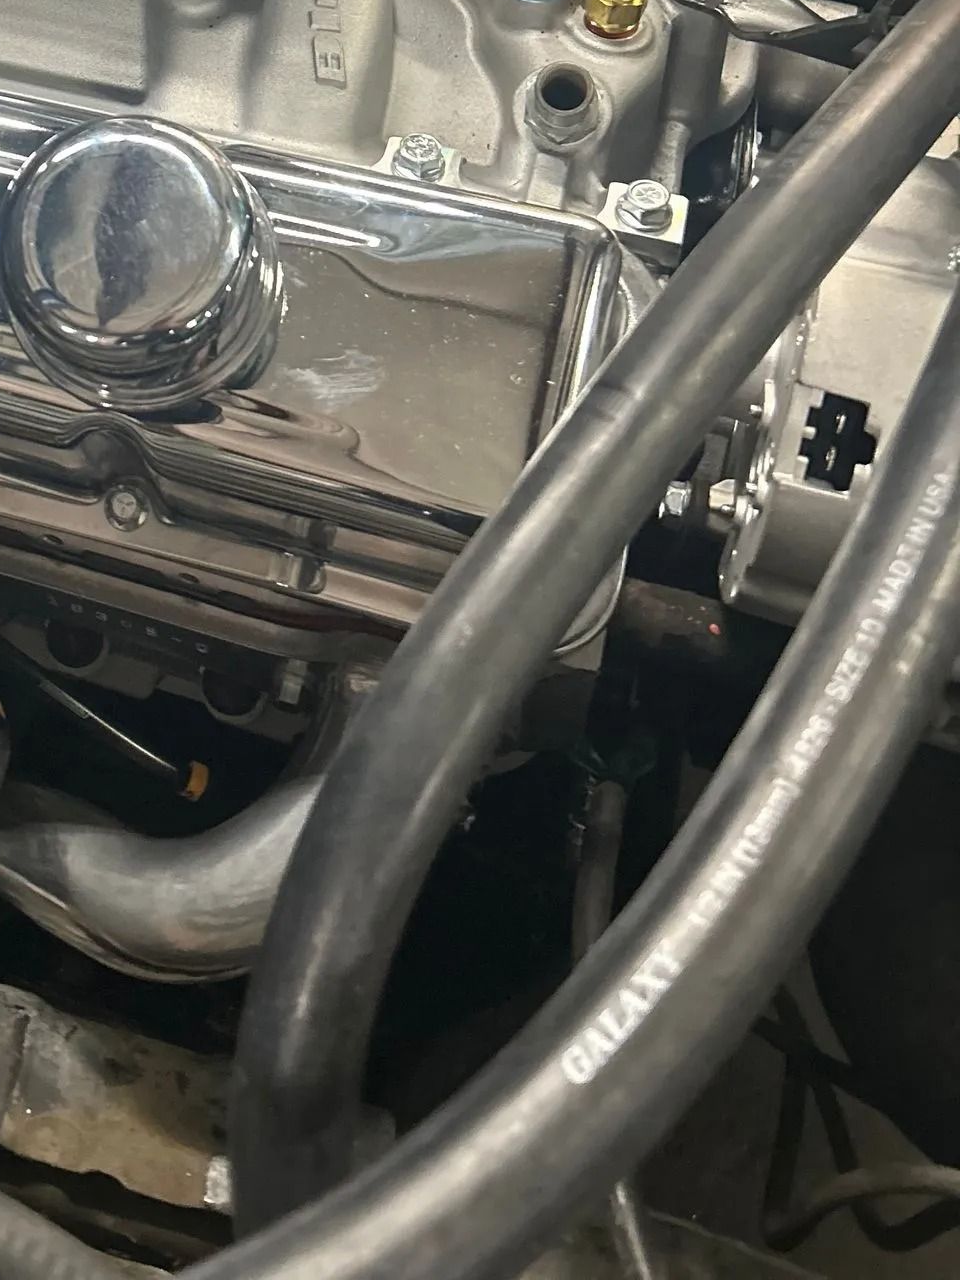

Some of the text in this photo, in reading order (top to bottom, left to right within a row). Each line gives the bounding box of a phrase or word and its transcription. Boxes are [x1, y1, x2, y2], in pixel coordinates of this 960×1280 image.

[917, 471, 952, 518] USA
[905, 517, 936, 546] IN
[872, 543, 922, 615] MADE
[855, 617, 887, 650] 10
[824, 647, 874, 704] SIZE
[561, 937, 682, 1085] GALAXY
